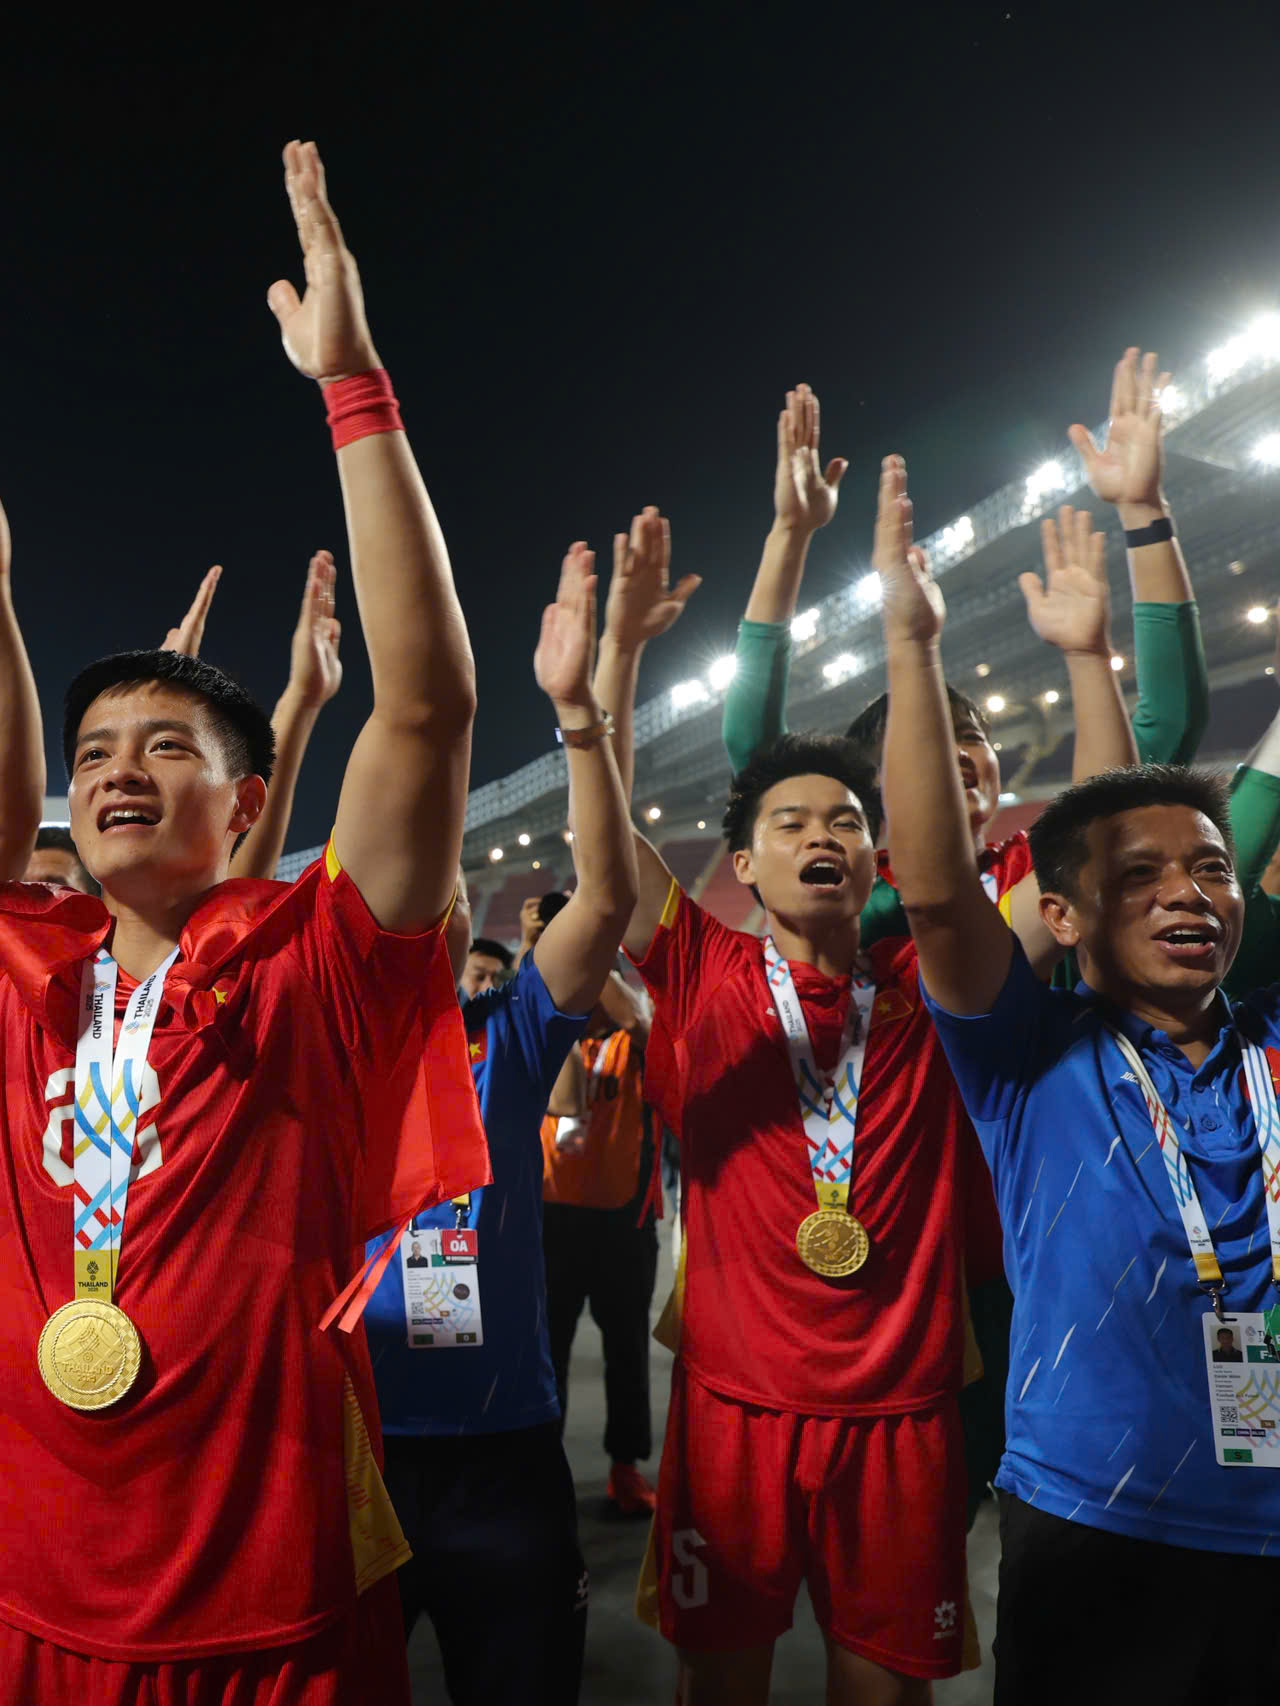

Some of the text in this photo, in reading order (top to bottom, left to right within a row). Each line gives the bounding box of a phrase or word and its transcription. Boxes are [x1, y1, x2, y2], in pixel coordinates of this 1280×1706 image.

[133, 974, 157, 1020] THAILAND
[92, 993, 105, 1039] THAILAND
[143, 998, 155, 1018] 2025
[450, 1240, 469, 1252] OA
[62, 1361, 115, 1376] THAILAND
